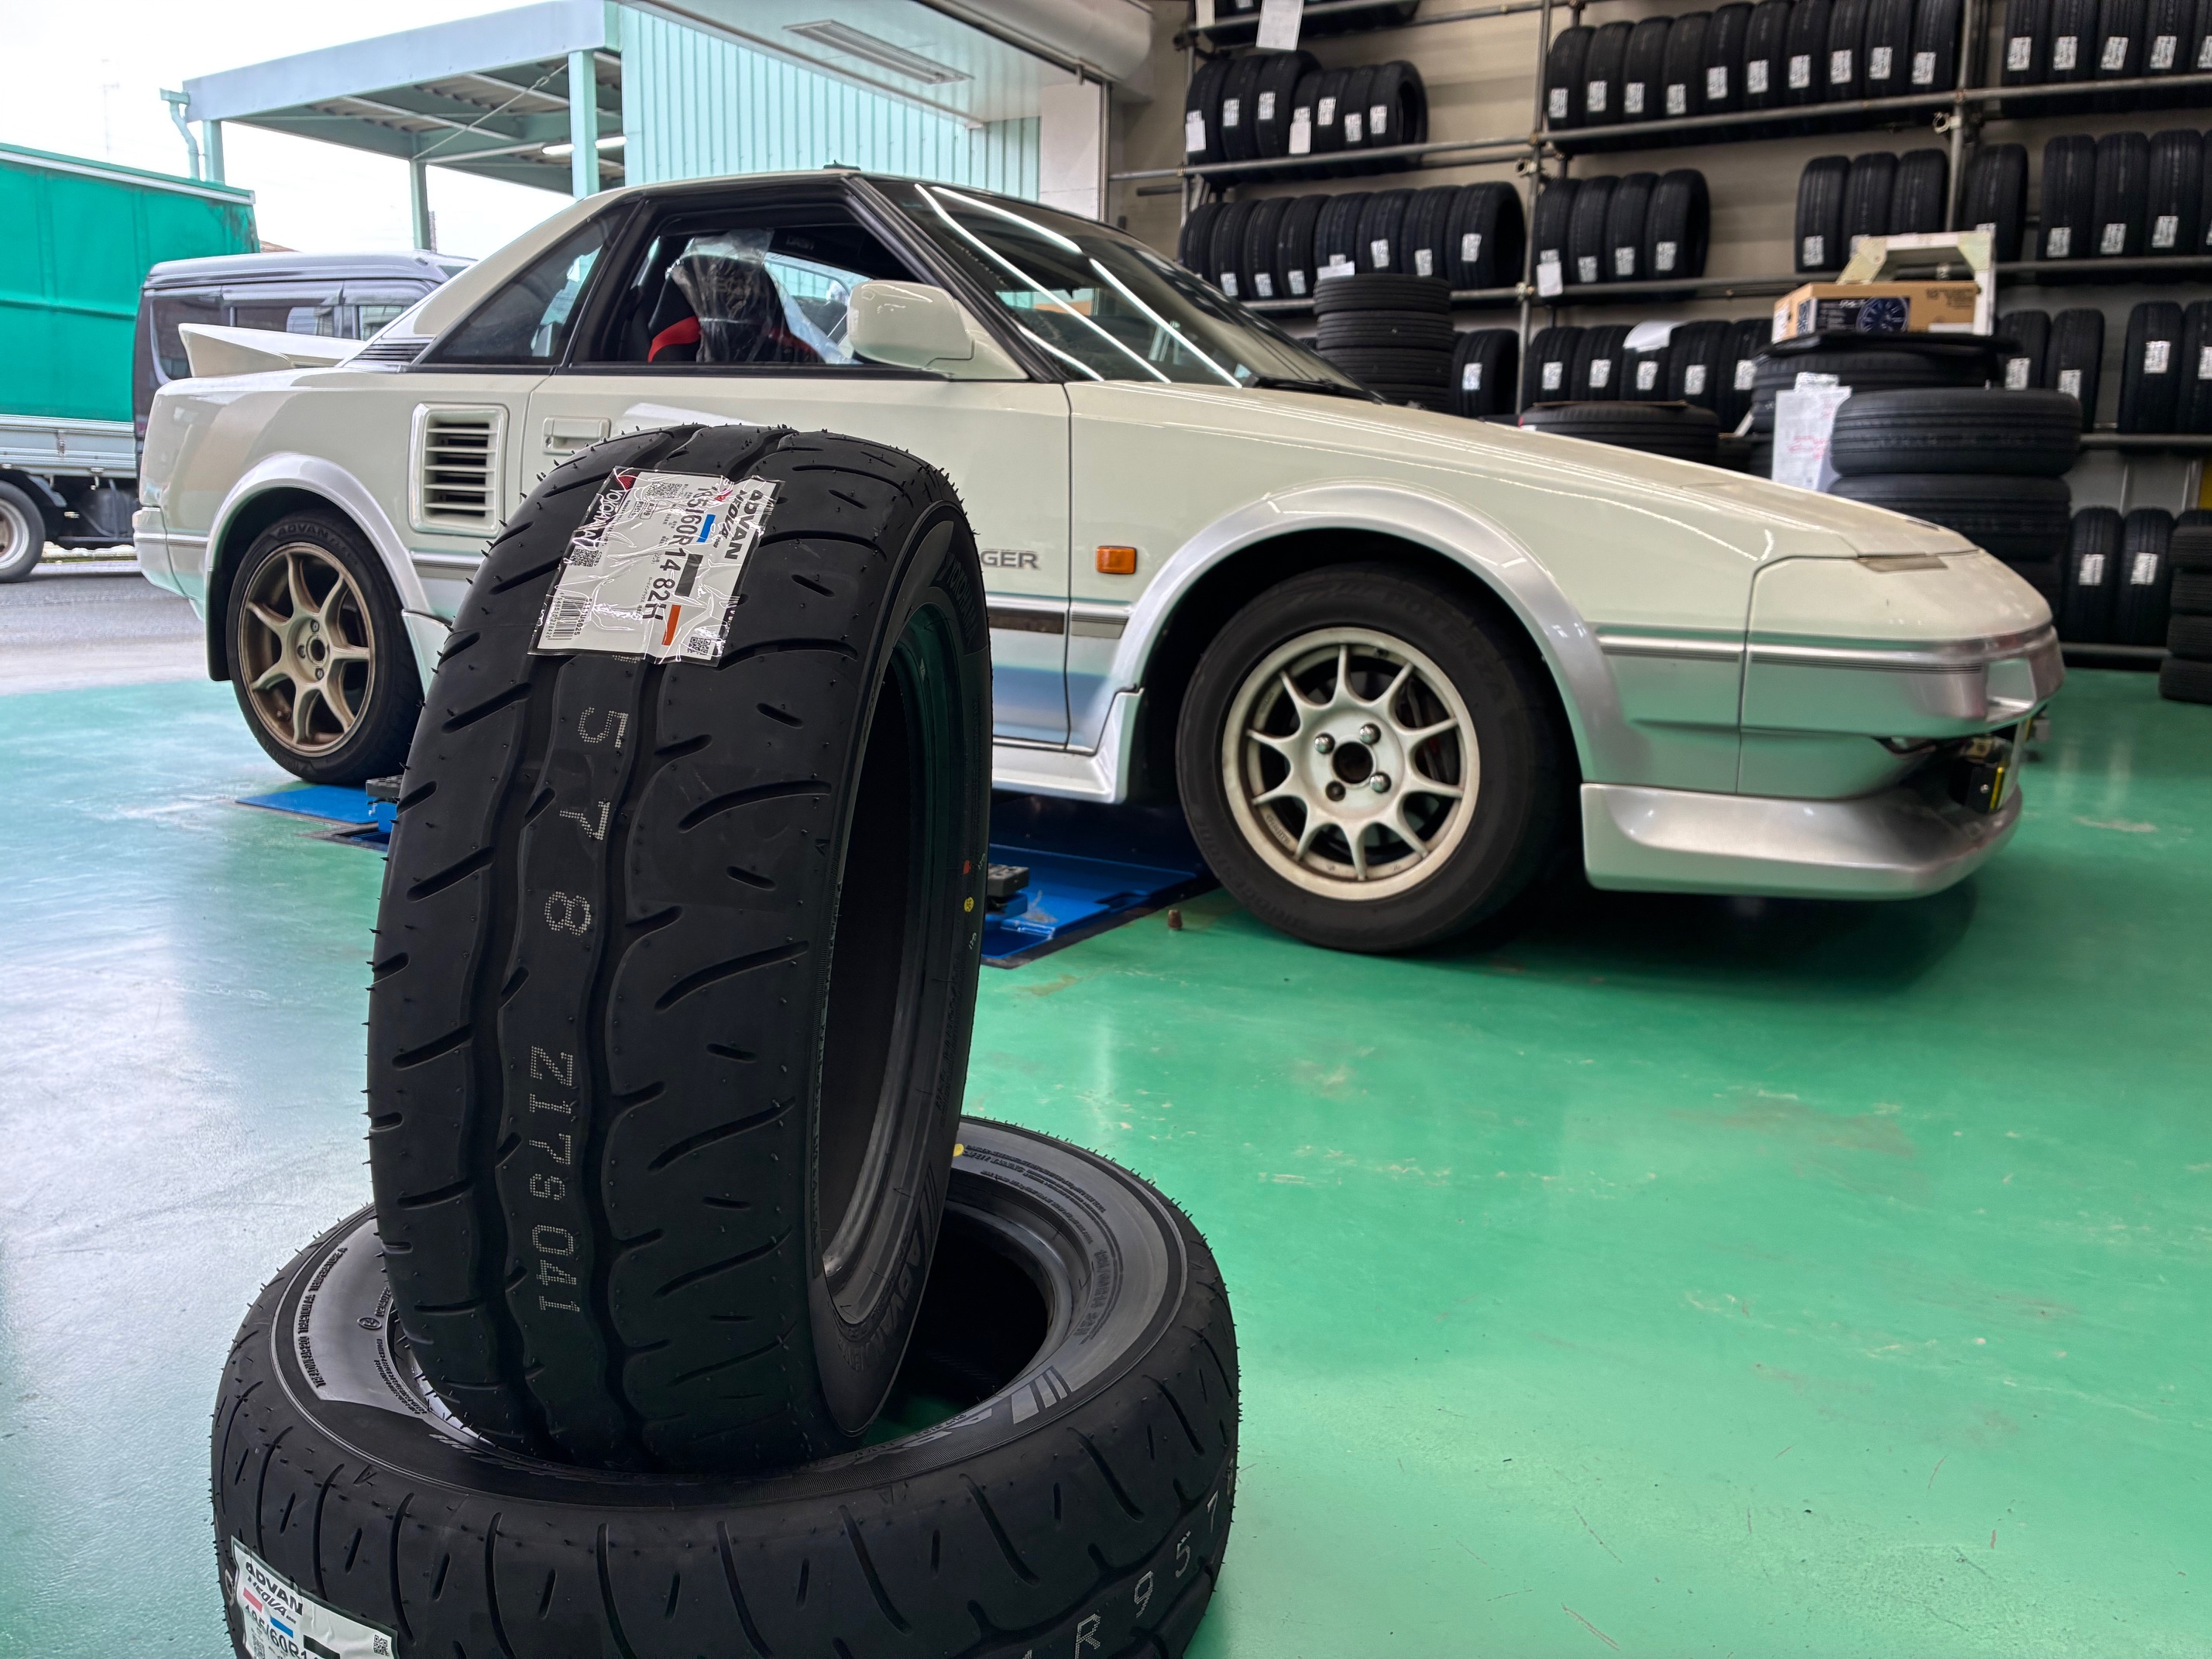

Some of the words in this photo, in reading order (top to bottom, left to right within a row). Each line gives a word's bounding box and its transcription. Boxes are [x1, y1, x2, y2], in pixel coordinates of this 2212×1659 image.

[724, 489, 764, 560] ADVAN
[642, 577, 675, 620] 82H
[246, 1561, 303, 1616] ADVAN
